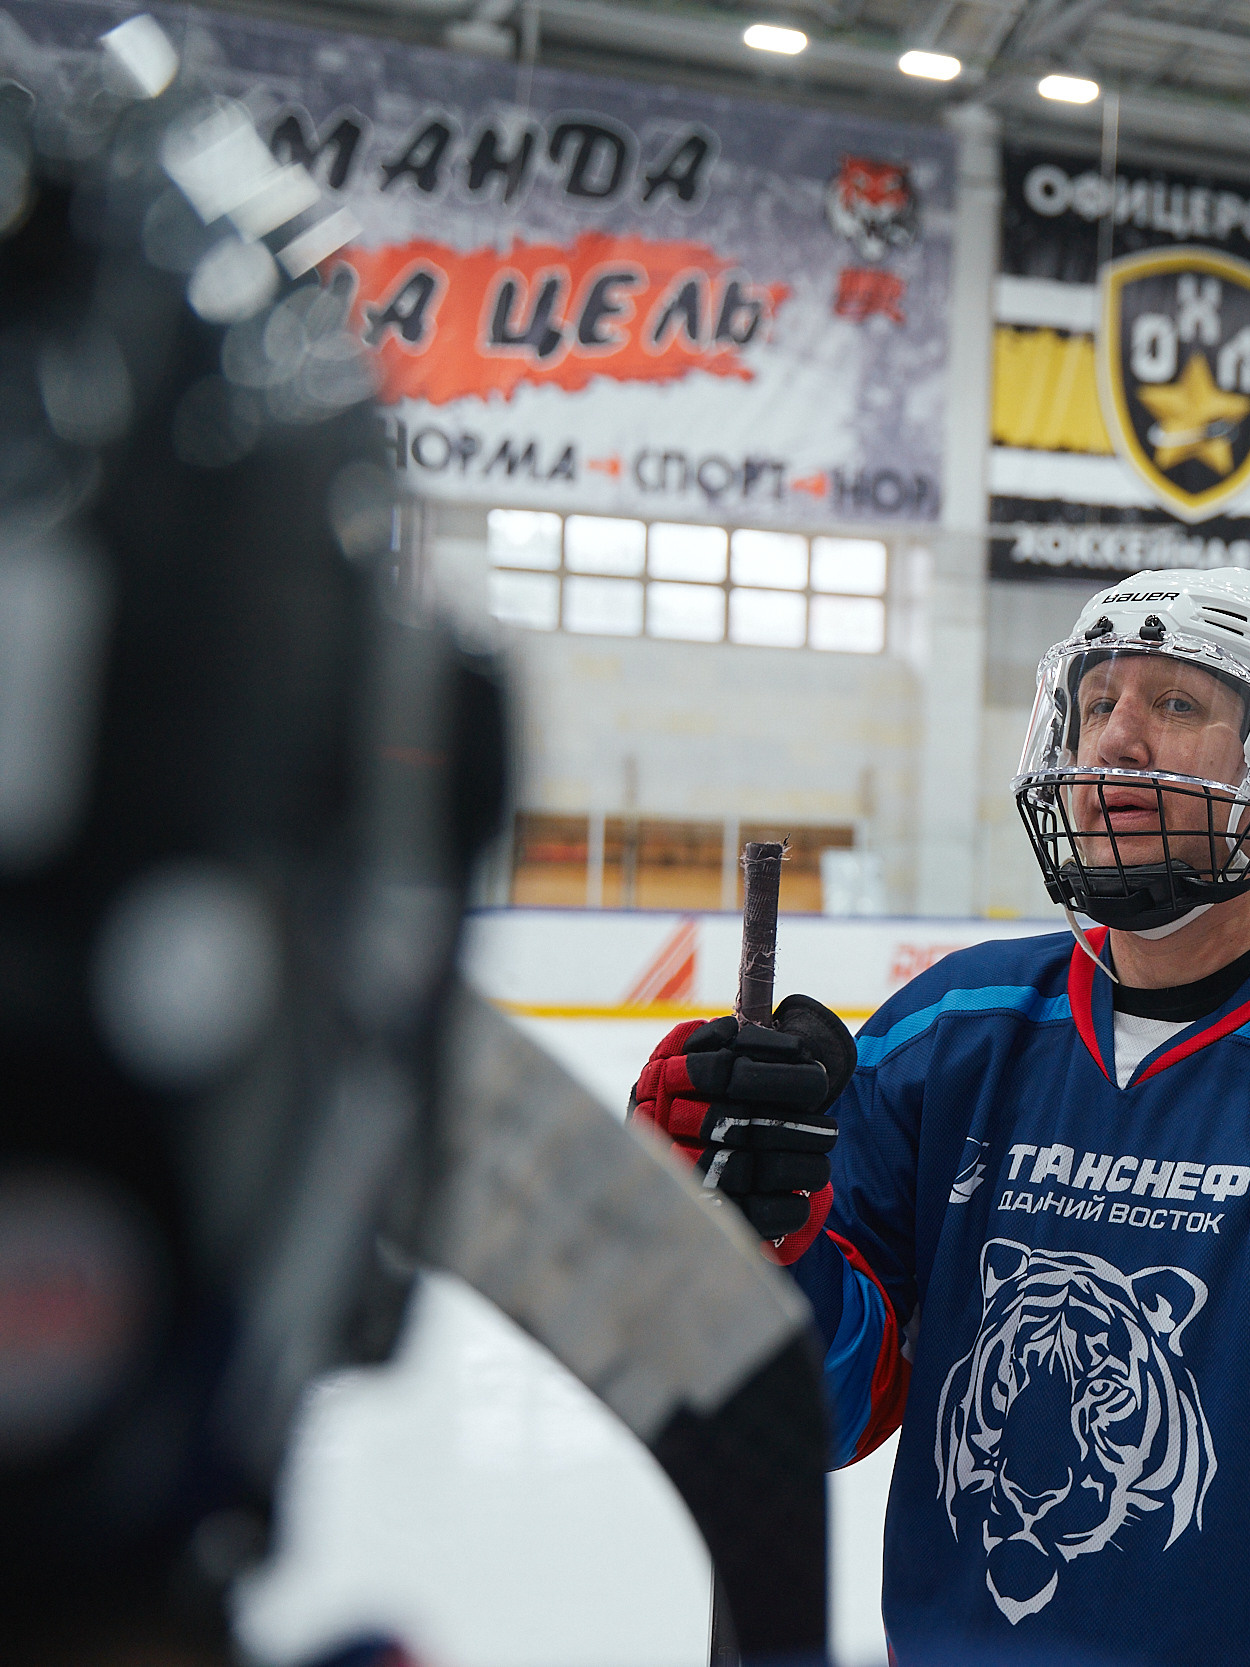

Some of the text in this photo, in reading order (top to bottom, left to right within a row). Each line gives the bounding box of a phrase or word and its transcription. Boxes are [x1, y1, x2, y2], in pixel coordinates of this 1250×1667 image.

[488, 273, 763, 360] ЦЕЛЬ
[633, 447, 788, 501] СПОРТ
[1101, 590, 1181, 605] BAUER
[1108, 1203, 1226, 1235] ВОСТОК
